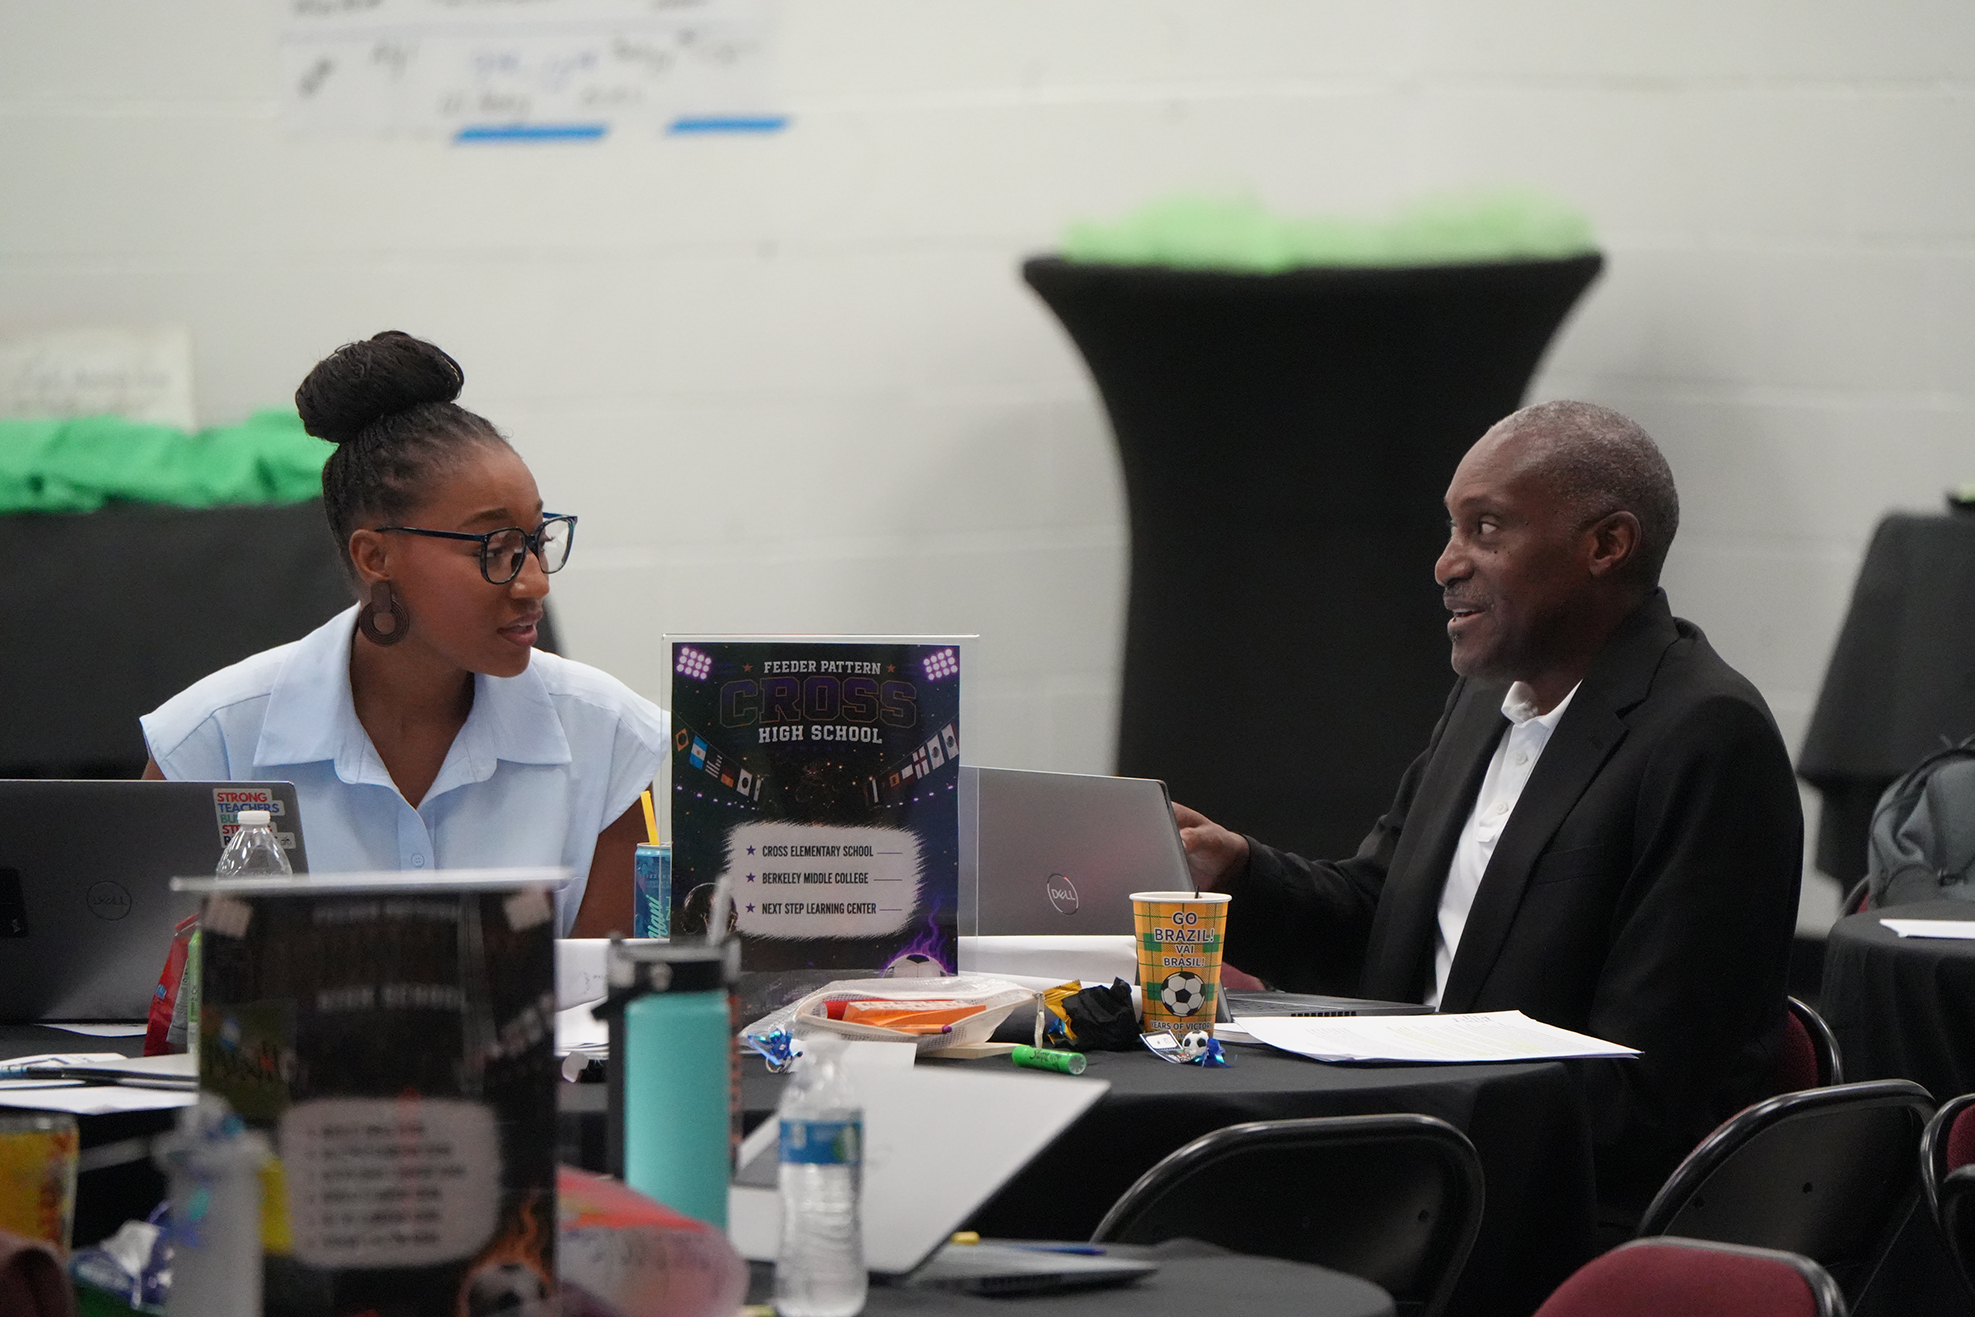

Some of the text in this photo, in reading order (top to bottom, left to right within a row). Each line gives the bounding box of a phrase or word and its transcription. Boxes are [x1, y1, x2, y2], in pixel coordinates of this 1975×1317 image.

[764, 660, 881, 675] FEEDER PATTERN
[719, 675, 917, 729] CROSS
[758, 725, 883, 744] HIGH SCHOOL
[216, 792, 268, 803] STRONG
[218, 802, 280, 814] TEACHERS
[762, 845, 874, 857] CROSS ELEMENTARY SCHOOL
[762, 872, 869, 884] BERKELEY MIDDLE COLLEGE
[1050, 888, 1076, 901] DELL
[761, 903, 877, 915] NEXT STEP LEARNING CENTER
[1172, 912, 1198, 925] GO
[1154, 928, 1215, 943] BRAZIL!
[1175, 945, 1195, 954] VAI
[1163, 957, 1206, 967] BRASIL!
[1172, 1021, 1184, 1031] OF
